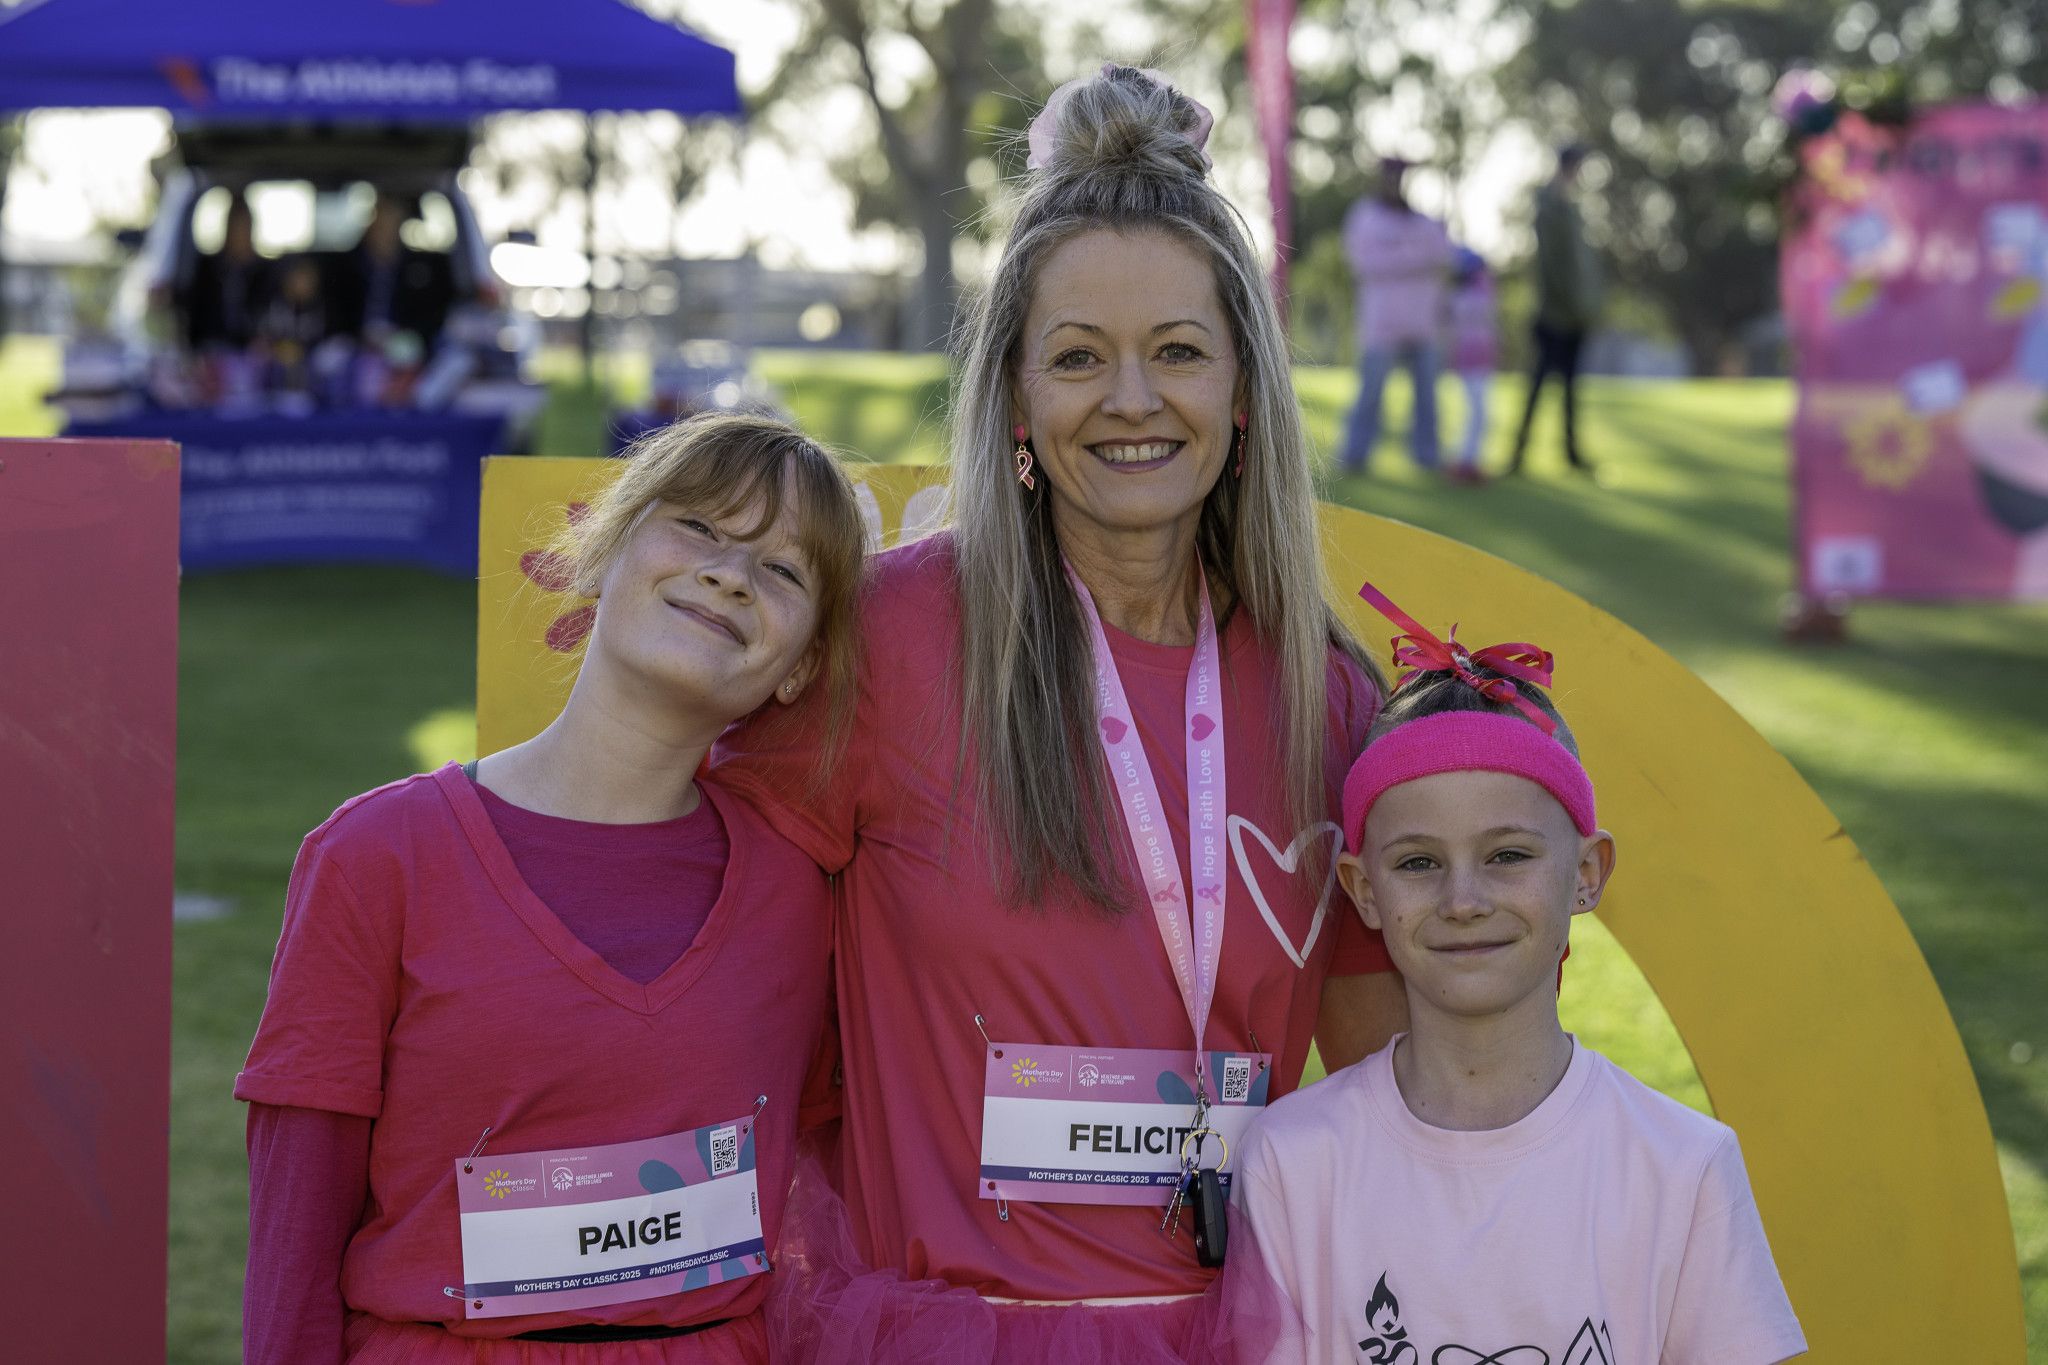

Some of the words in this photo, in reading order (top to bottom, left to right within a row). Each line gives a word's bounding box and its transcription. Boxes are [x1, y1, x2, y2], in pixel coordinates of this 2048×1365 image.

[1195, 665, 1211, 706] Hope
[1120, 750, 1140, 788] Love
[1199, 749, 1212, 785] Love
[1132, 791, 1154, 833] Faith
[1199, 790, 1213, 830] Faith
[1147, 836, 1167, 880] Hope
[1202, 835, 1217, 878] Hope
[1168, 910, 1183, 949] Love
[1203, 910, 1214, 948] Love
[1051, 1070, 1064, 1078] Day
[495, 1179, 523, 1187] Mother's
[523, 1178, 537, 1186] Day
[512, 1185, 535, 1193] Classic
[1028, 1171, 1074, 1181] MOTHER'S
[1075, 1173, 1093, 1182] DAY
[1094, 1174, 1129, 1183] CLASSIC
[1130, 1175, 1150, 1183] 2025
[579, 1211, 681, 1255] PAIGE
[514, 1280, 561, 1293] MOTHER'S
[562, 1278, 581, 1288] DAY
[582, 1273, 618, 1286] CLASSIC
[620, 1269, 641, 1280] 2025
[649, 1250, 729, 1276] #MOTHERSDAYCLASSIC
